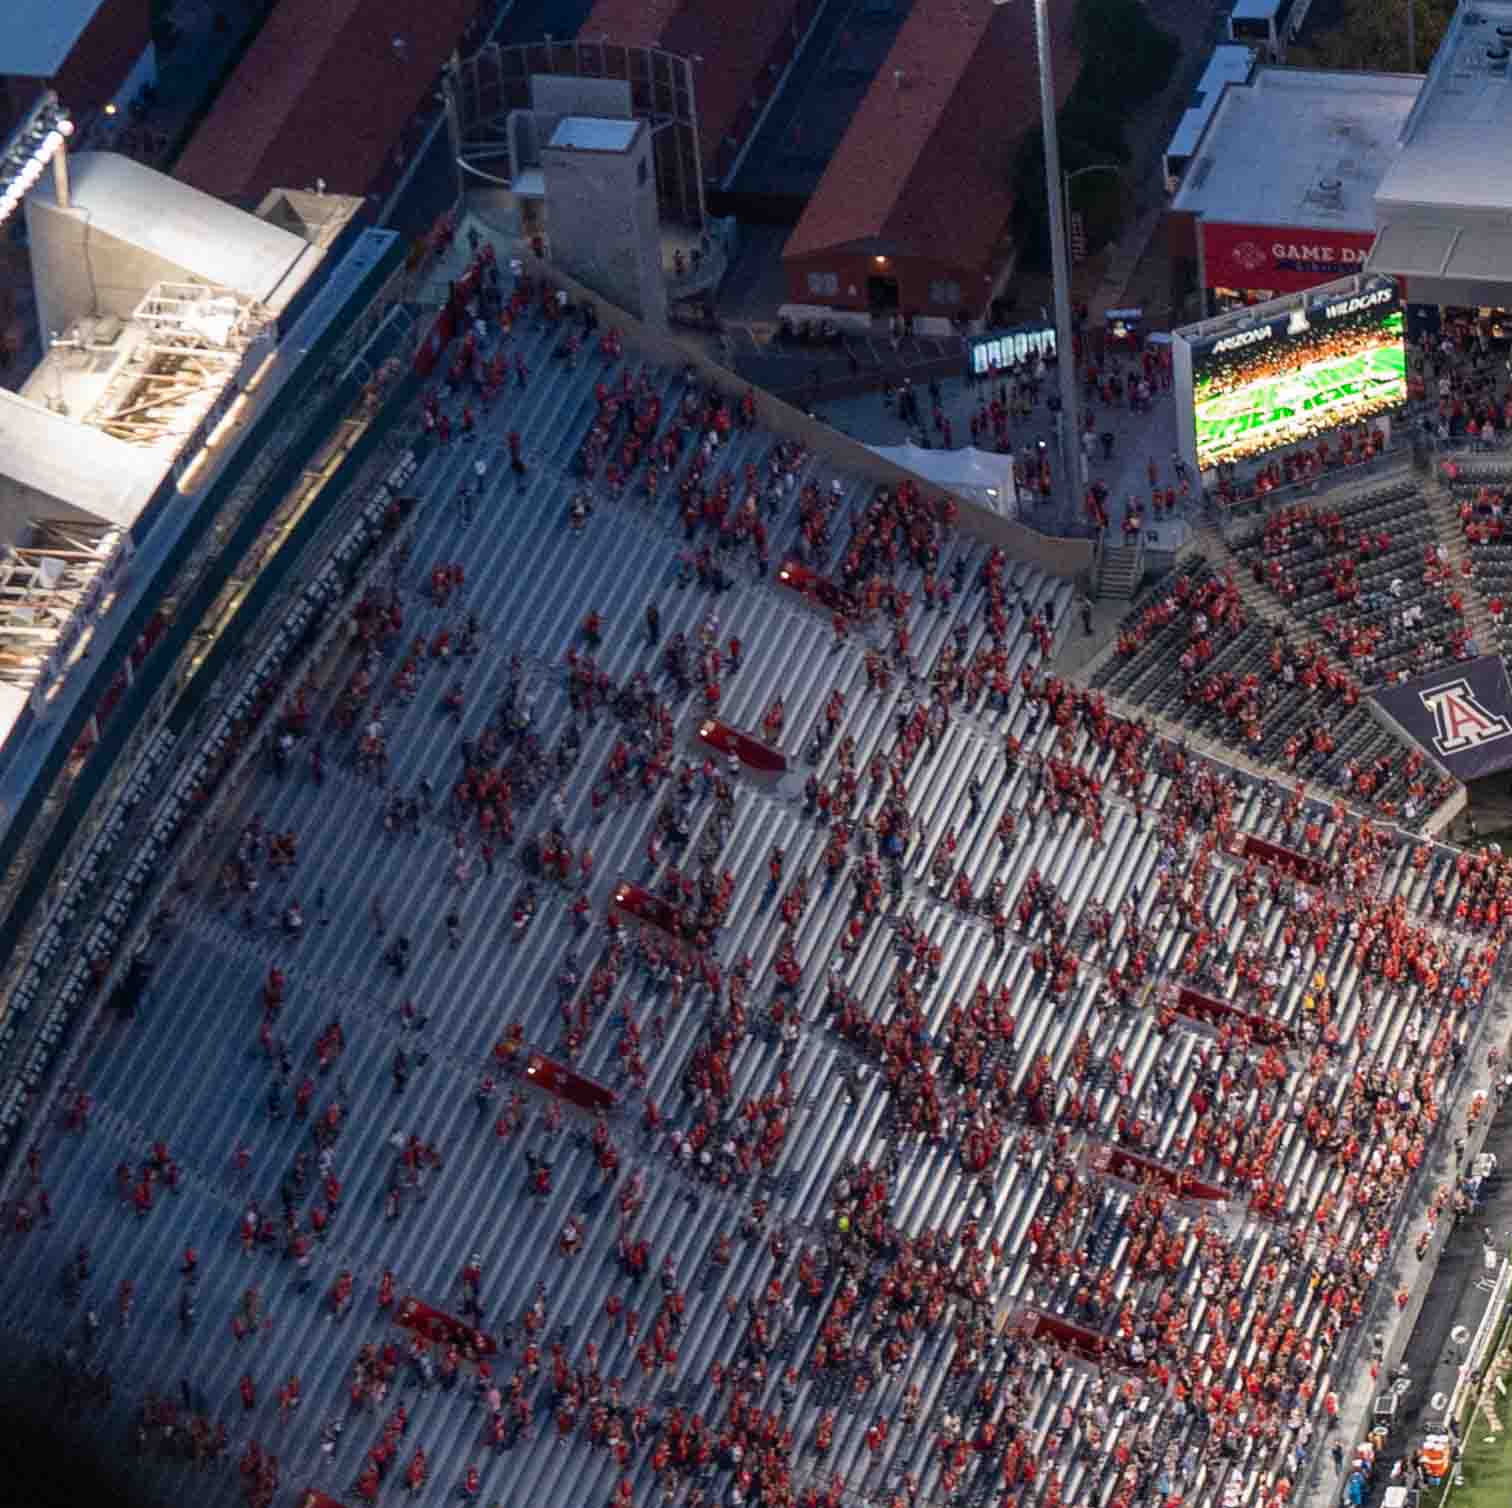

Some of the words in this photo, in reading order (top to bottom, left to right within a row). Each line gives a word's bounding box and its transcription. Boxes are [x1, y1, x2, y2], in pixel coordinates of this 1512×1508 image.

[1271, 243, 1332, 263] GAME
[1326, 288, 1393, 319] WILDCATS
[1211, 325, 1272, 355] ARIZONA
